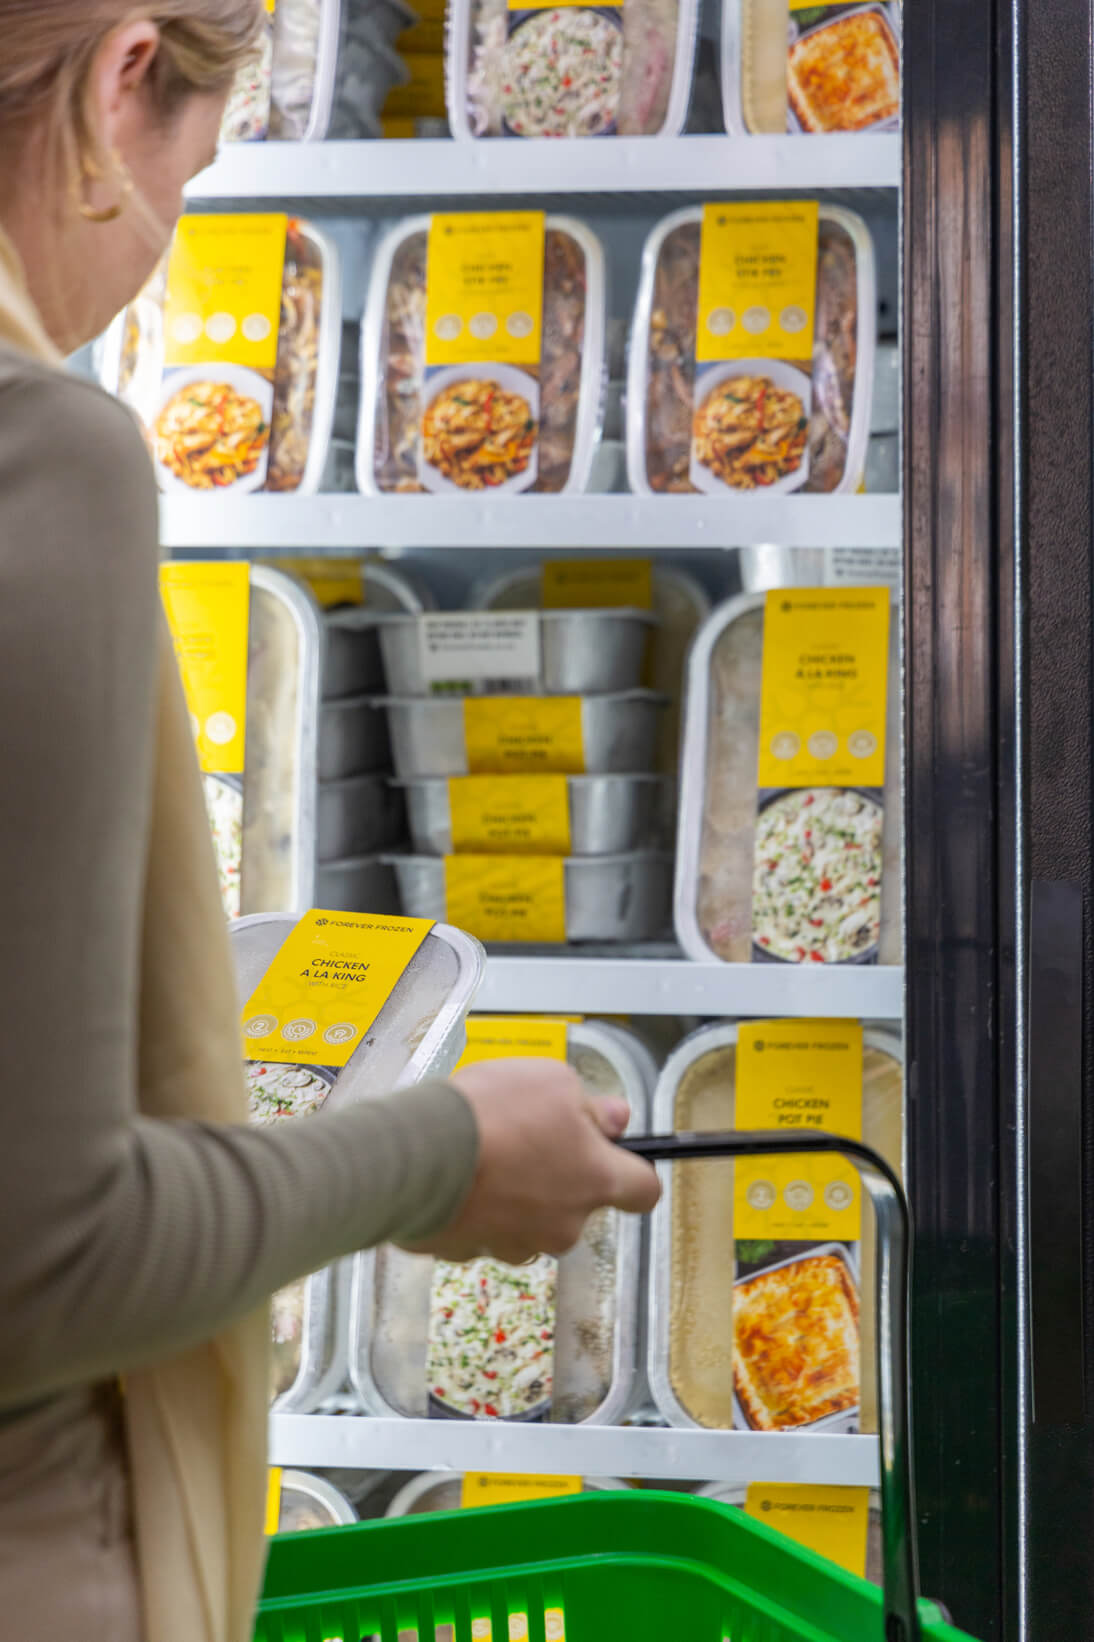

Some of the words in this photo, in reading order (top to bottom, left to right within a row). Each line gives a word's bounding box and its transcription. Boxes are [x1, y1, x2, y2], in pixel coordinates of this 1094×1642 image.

[798, 654, 856, 665] CHICKEN
[330, 920, 374, 930] FOREVER
[375, 924, 414, 933] FROZEN
[311, 958, 371, 971] CHICKEN
[300, 968, 310, 977] A
[313, 970, 329, 979] LA
[332, 971, 367, 983] KING
[773, 1098, 830, 1109] CHICKEN
[778, 1113, 802, 1125] POT
[805, 1113, 824, 1125] PIE
